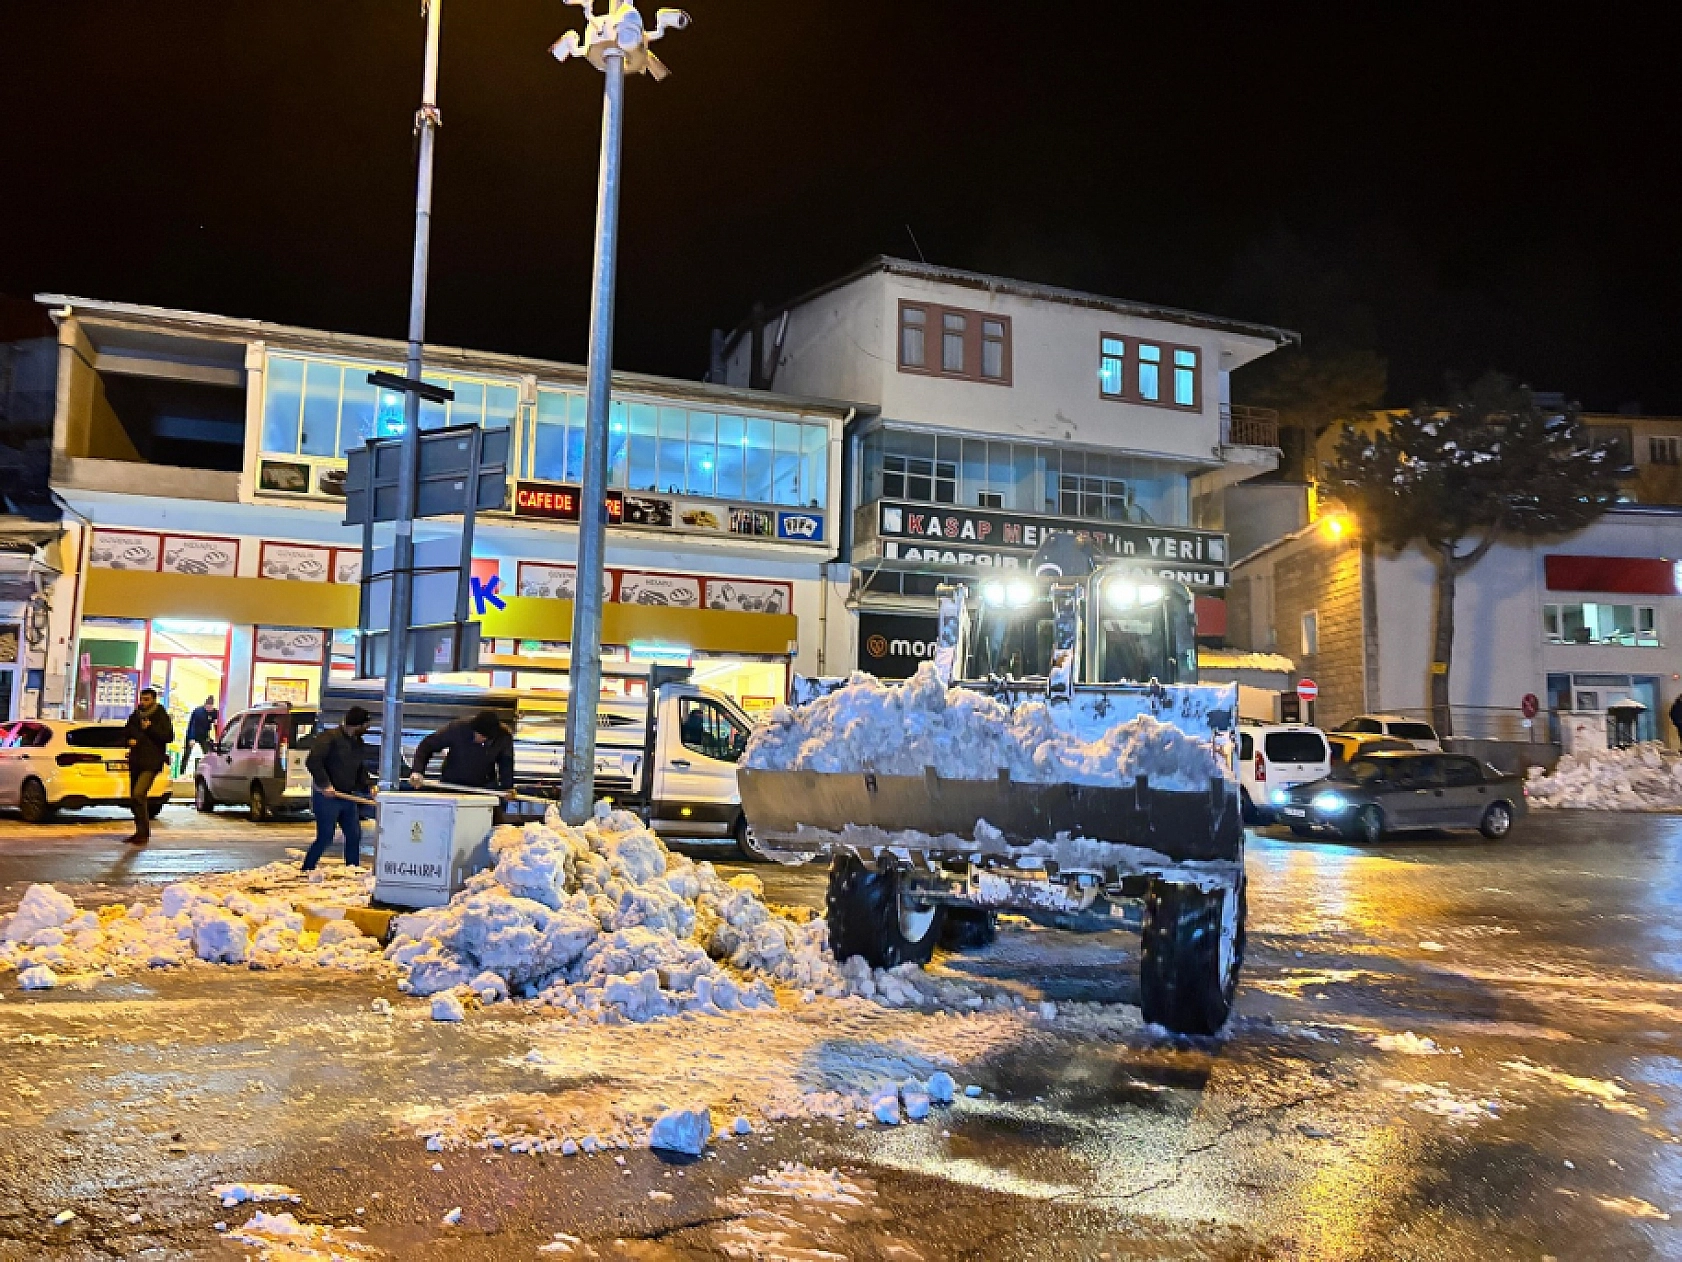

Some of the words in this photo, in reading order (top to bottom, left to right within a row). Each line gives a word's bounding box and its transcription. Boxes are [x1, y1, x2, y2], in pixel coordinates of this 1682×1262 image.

[518, 490, 552, 509] CAFE
[555, 494, 572, 511] DE
[908, 513, 992, 540] KASAP
